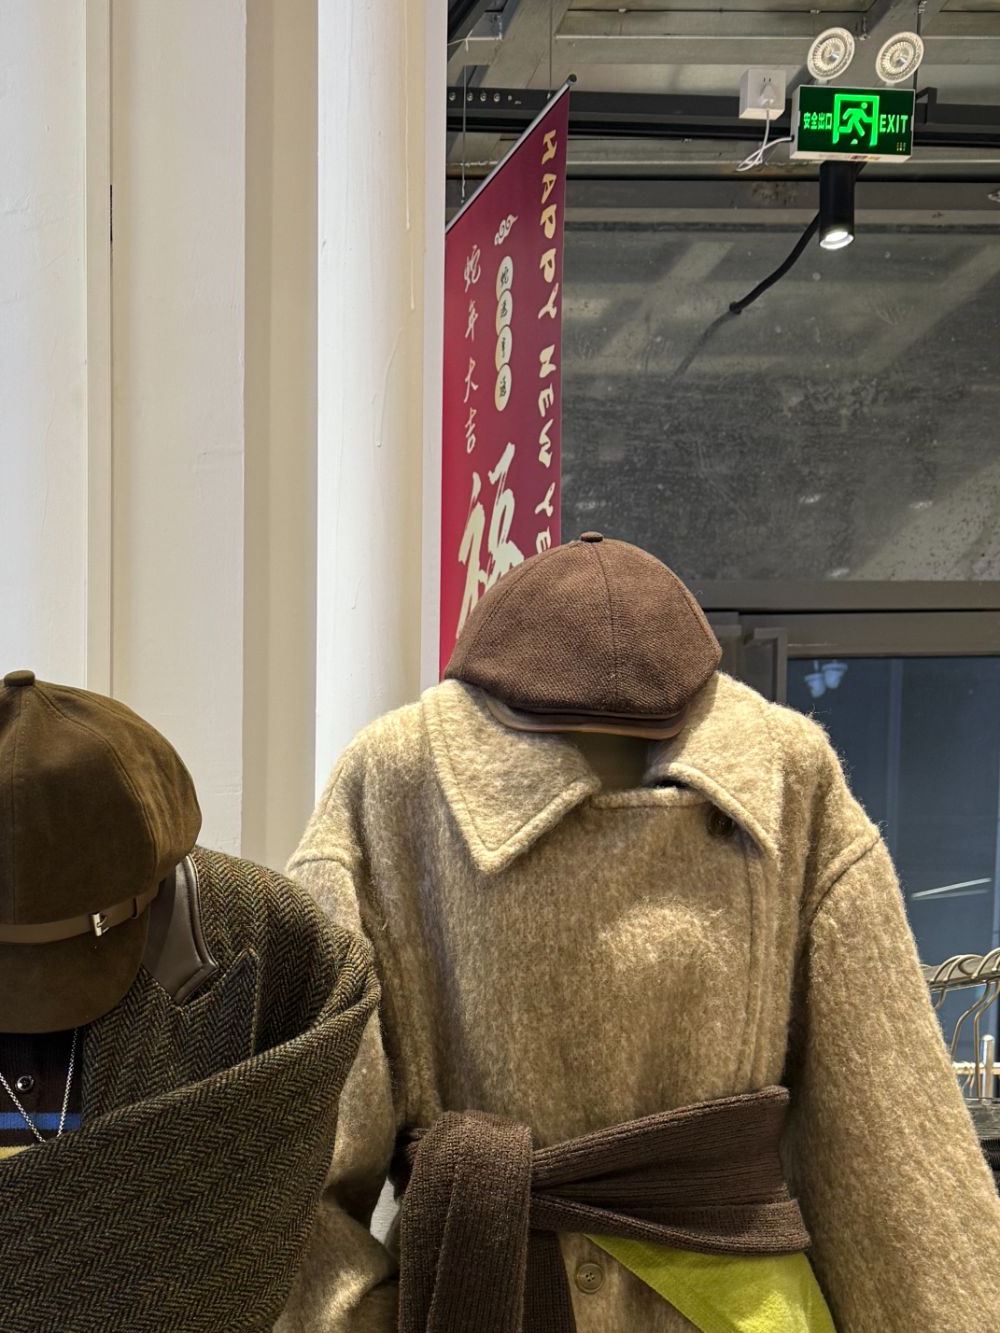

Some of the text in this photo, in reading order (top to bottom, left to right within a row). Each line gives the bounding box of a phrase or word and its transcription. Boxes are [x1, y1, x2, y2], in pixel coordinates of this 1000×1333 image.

[803, 111, 833, 131] 安全出口
[879, 113, 908, 133] EXIT
[463, 244, 481, 454] 蛇年大吉
[535, 129, 559, 553] HAPPY NEW YE
